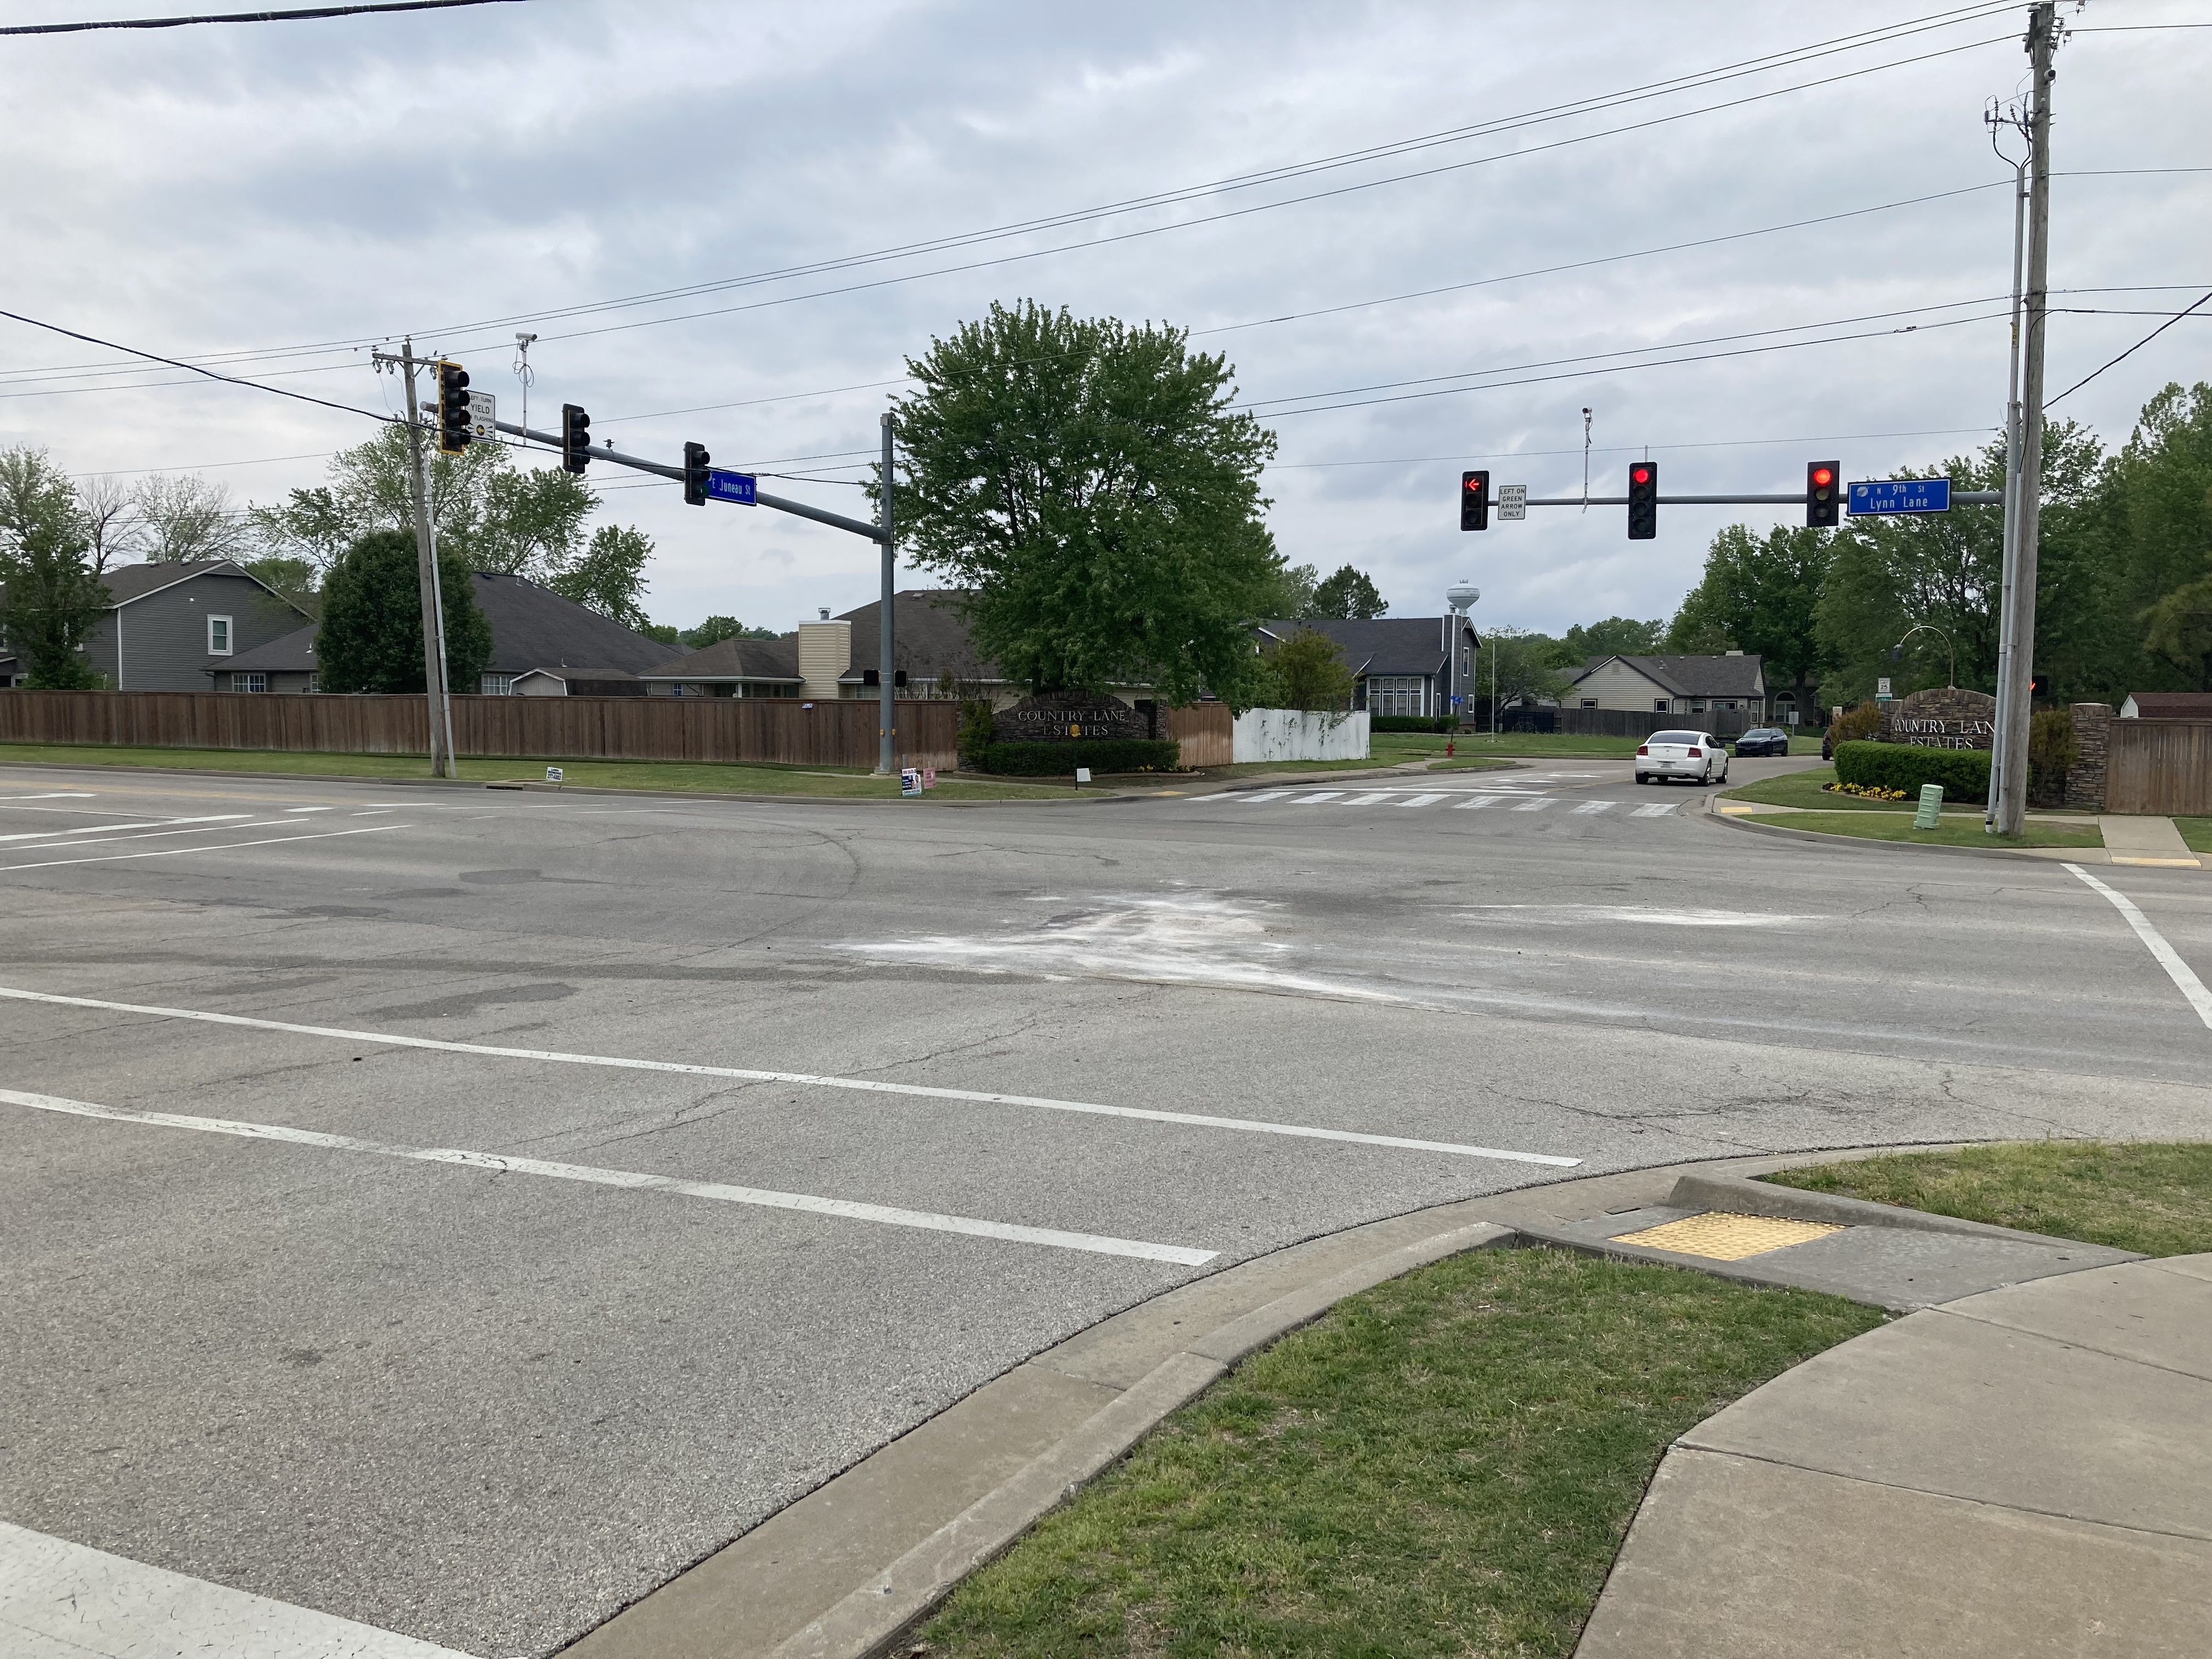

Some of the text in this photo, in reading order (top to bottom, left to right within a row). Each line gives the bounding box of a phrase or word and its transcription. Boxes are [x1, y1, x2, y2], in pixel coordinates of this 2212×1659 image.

[471, 403, 490, 414] YIELD
[475, 415, 494, 424] FLASHING
[712, 478, 751, 495] E Juneau St
[1892, 484, 1906, 496] 9th
[1918, 485, 1925, 493] St
[1870, 496, 1928, 512] Lynn Lane
[1018, 710, 1125, 721] COUNTRY LANE
[1043, 725, 1108, 736] ESTTES
[1895, 719, 1995, 735] COUNTRY LAN
[1910, 736, 1973, 749] ESTATES
